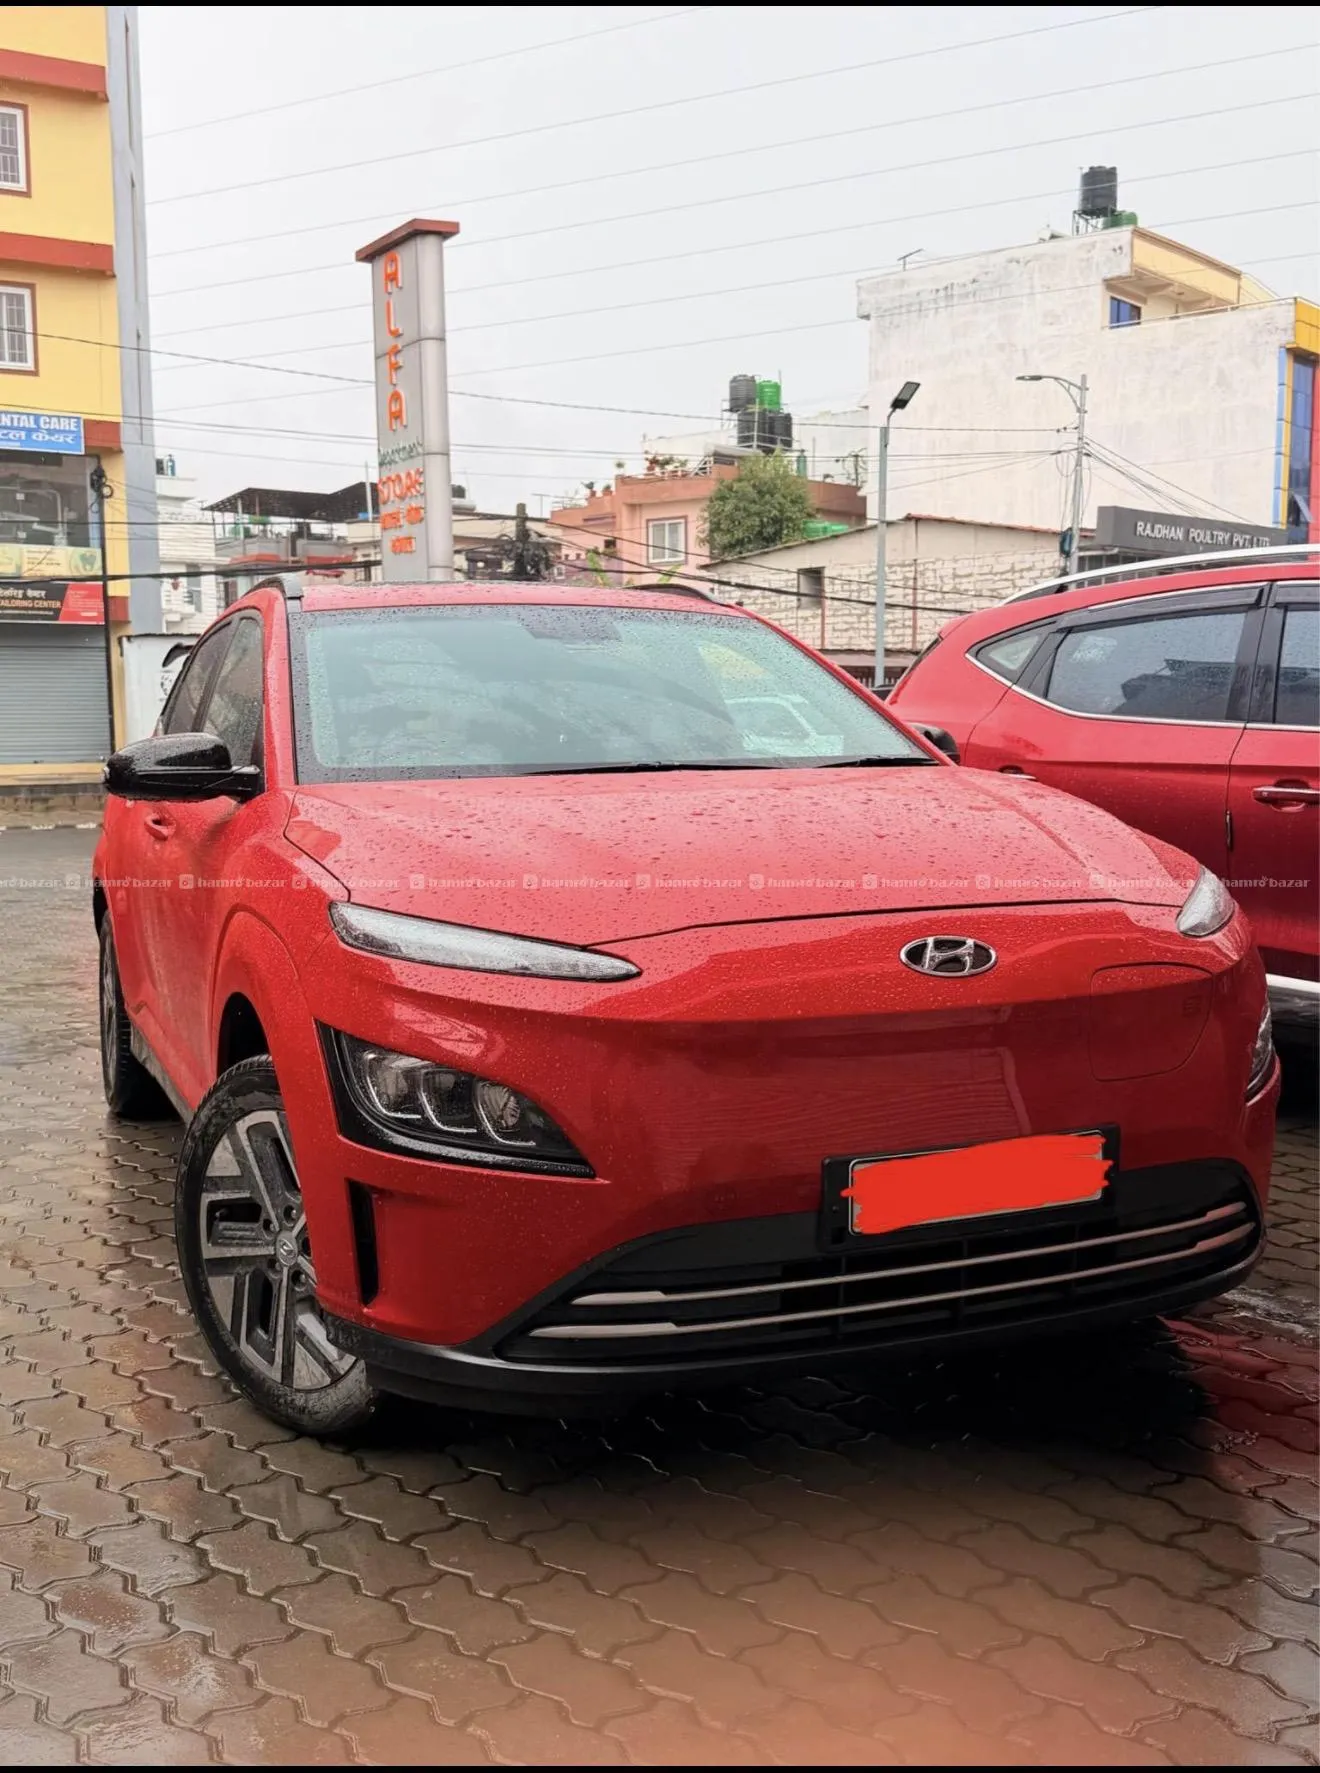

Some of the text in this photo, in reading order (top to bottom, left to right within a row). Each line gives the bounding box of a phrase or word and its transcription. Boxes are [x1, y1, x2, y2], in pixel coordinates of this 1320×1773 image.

[384, 251, 408, 432] ALFA
[0, 412, 79, 431] NTAL CARE
[1136, 521, 1183, 541] RAJDHAN
[1188, 528, 1230, 546] POULTRY
[0, 599, 33, 608] AILORING
